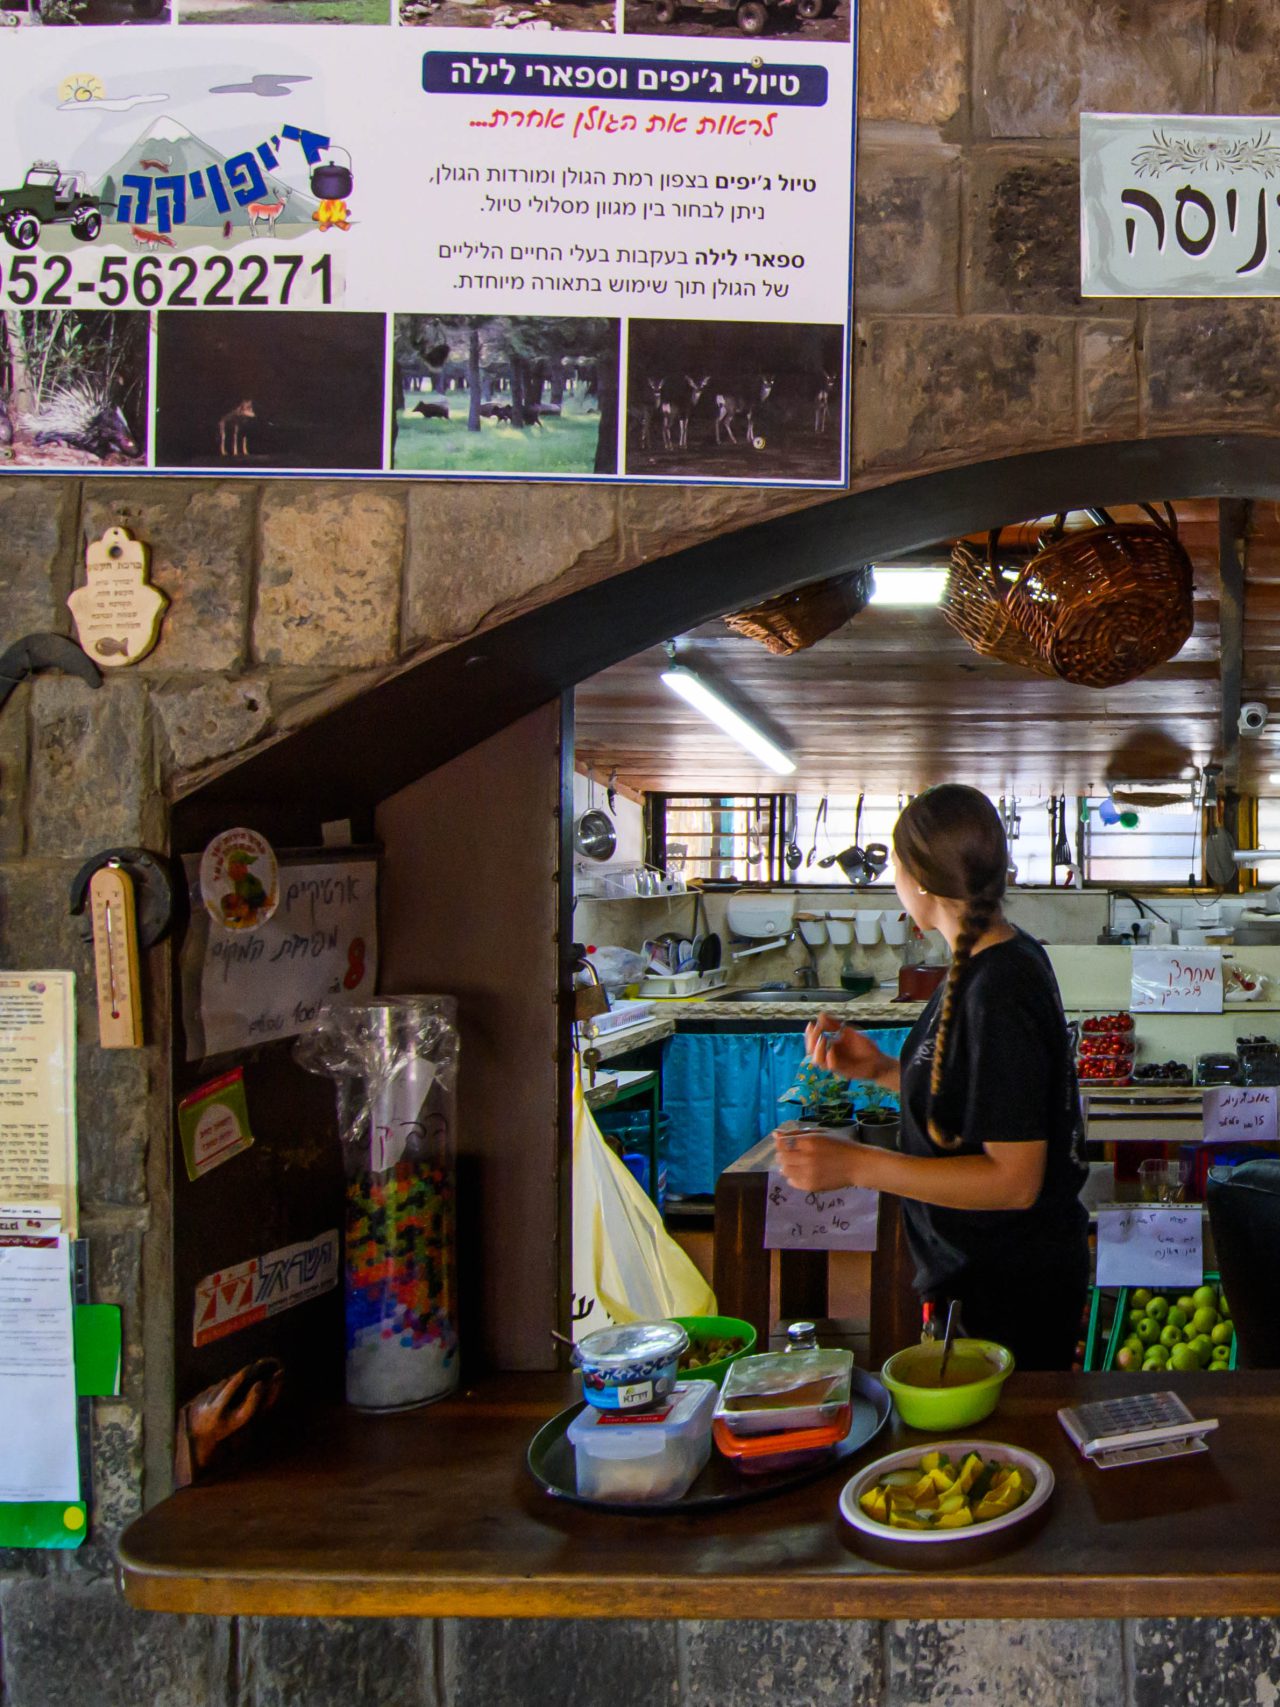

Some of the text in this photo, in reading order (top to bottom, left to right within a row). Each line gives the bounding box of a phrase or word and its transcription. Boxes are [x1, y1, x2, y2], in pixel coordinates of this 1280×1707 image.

[451, 58, 516, 85] לילה
[525, 61, 628, 90] וספארי
[733, 68, 800, 96] טיולי
[573, 105, 636, 138] הגולן
[645, 113, 688, 135] את
[696, 112, 778, 137] לראות
[428, 163, 480, 184] הגולן,
[486, 167, 555, 184] ומורדות
[562, 166, 605, 188] הגולן
[612, 172, 653, 187] רמת
[659, 173, 709, 191] בצפון
[779, 170, 817, 193] טיול
[480, 195, 766, 221] ניתן לבחור בין מגוון מסלולי טיול.
[438, 241, 806, 270] ספארי לילה בעקבות בעלי החיים הליליים
[0, 253, 333, 307] 52-5622271
[452, 273, 790, 298] של הגולן תוך שימוש בתאורה מיוחדת.
